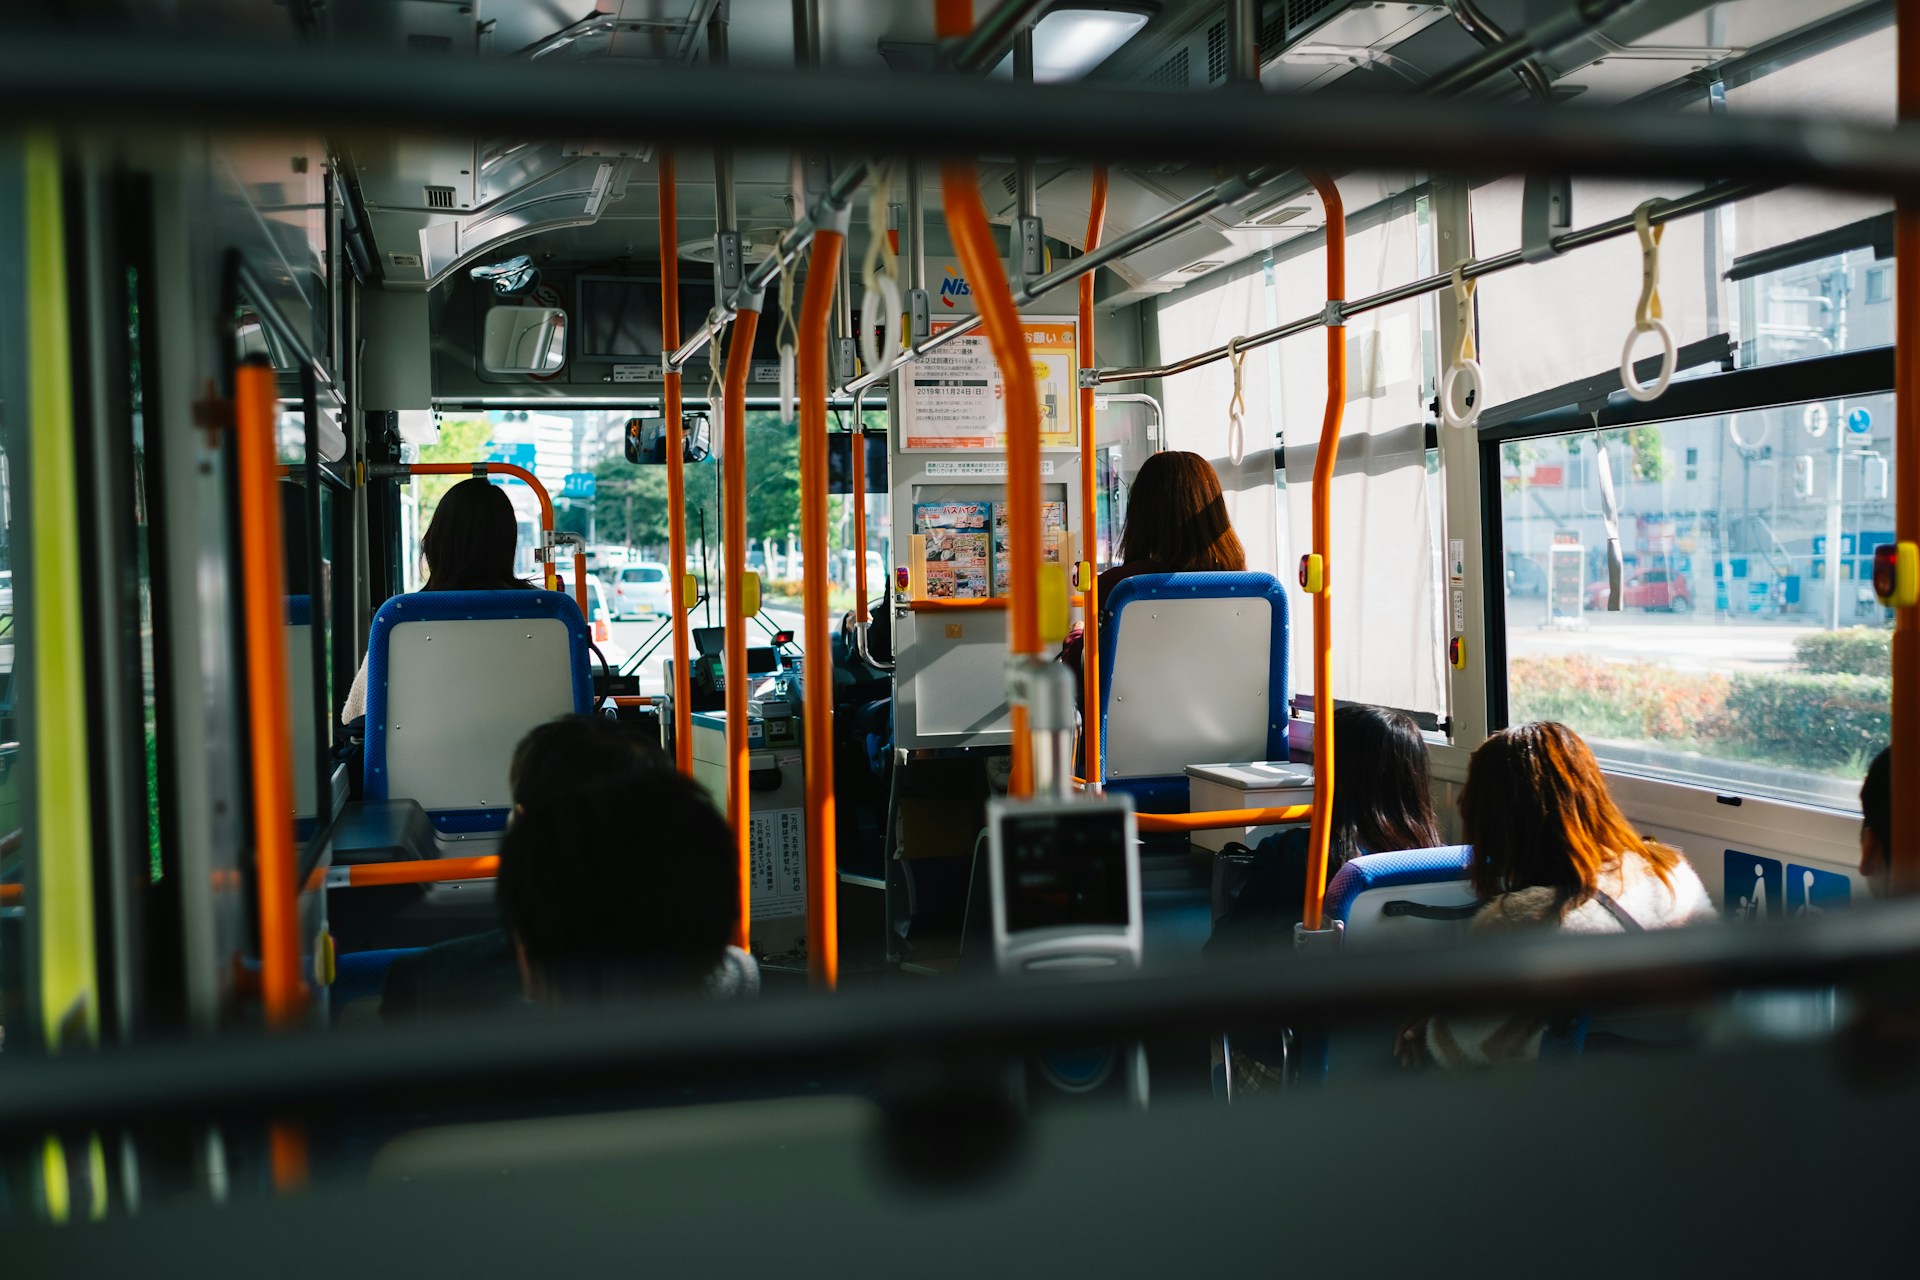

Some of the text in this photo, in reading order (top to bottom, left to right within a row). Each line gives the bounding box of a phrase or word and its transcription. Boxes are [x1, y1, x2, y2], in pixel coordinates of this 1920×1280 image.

[940, 278, 973, 296] Nis
[1024, 331, 1057, 344] お願い
